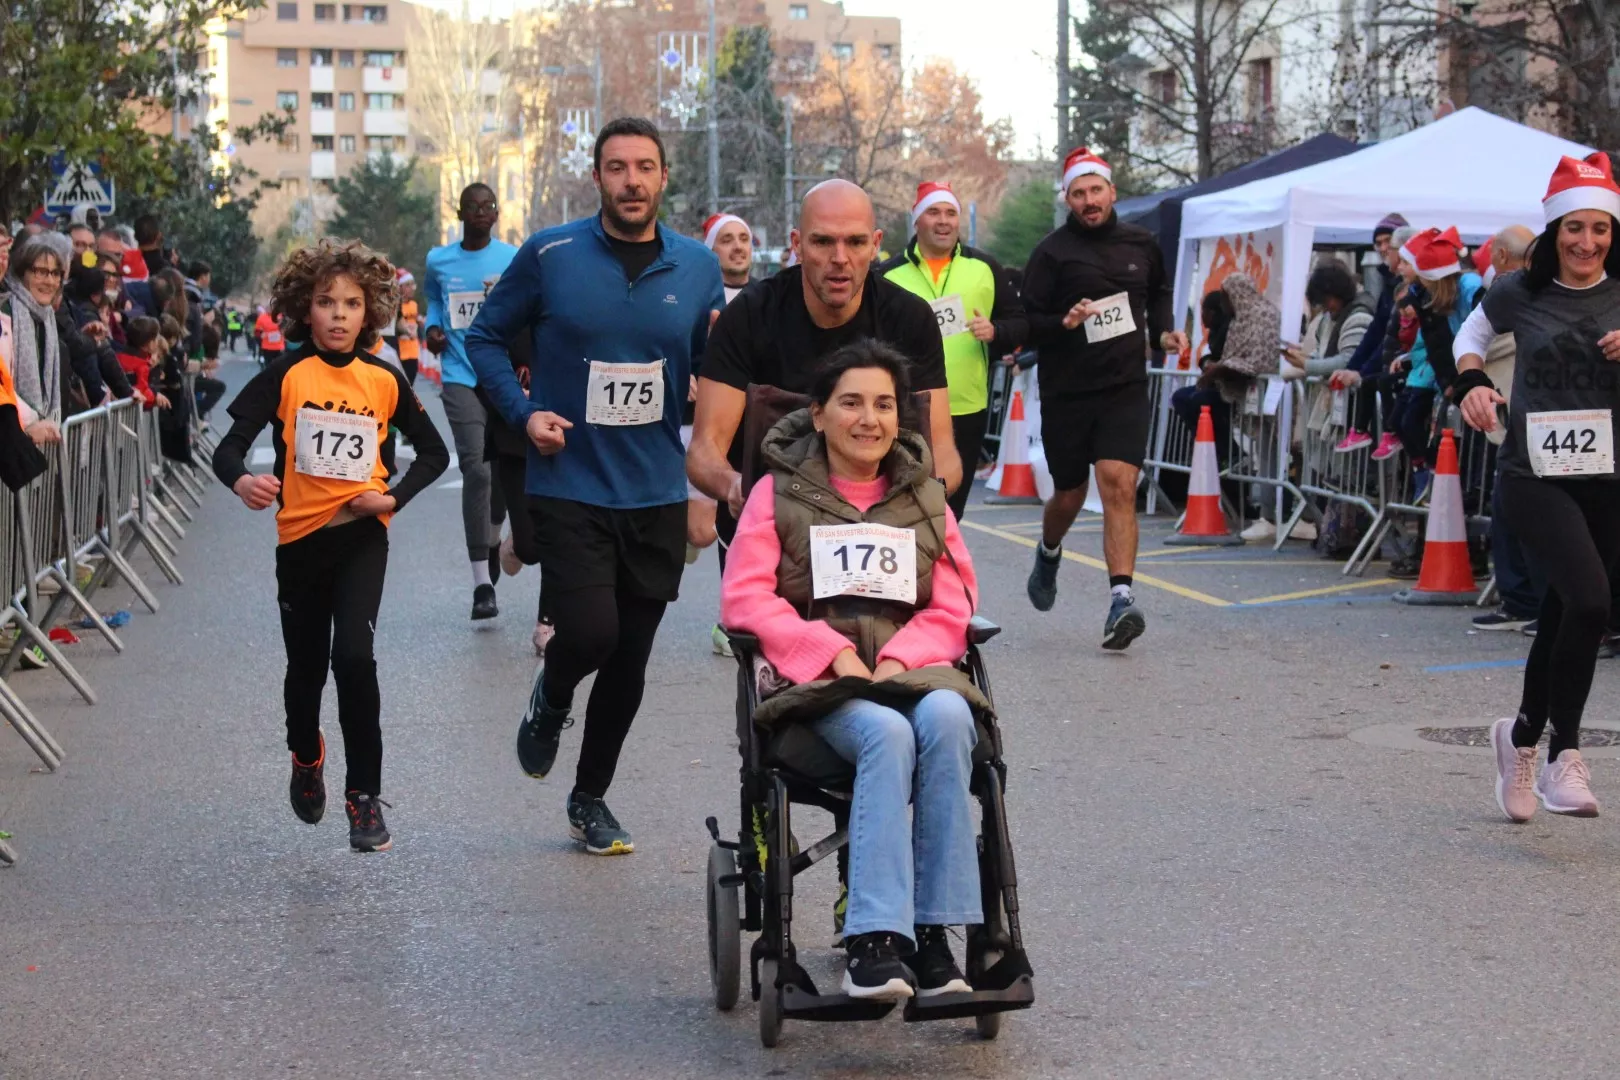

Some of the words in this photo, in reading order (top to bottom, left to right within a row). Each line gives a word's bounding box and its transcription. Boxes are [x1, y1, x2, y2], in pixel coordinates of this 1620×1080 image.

[934, 307, 956, 326] 53
[1093, 306, 1123, 327] 452
[1524, 362, 1617, 391] adida
[603, 381, 653, 406] 175
[311, 429, 364, 460] 173
[1542, 428, 1596, 455] 442
[815, 530, 824, 538] XVI
[824, 530, 836, 538] SAN
[836, 528, 864, 538] SILVESTRE
[864, 527, 890, 538] SOLIDARIA
[833, 543, 898, 575] 178
